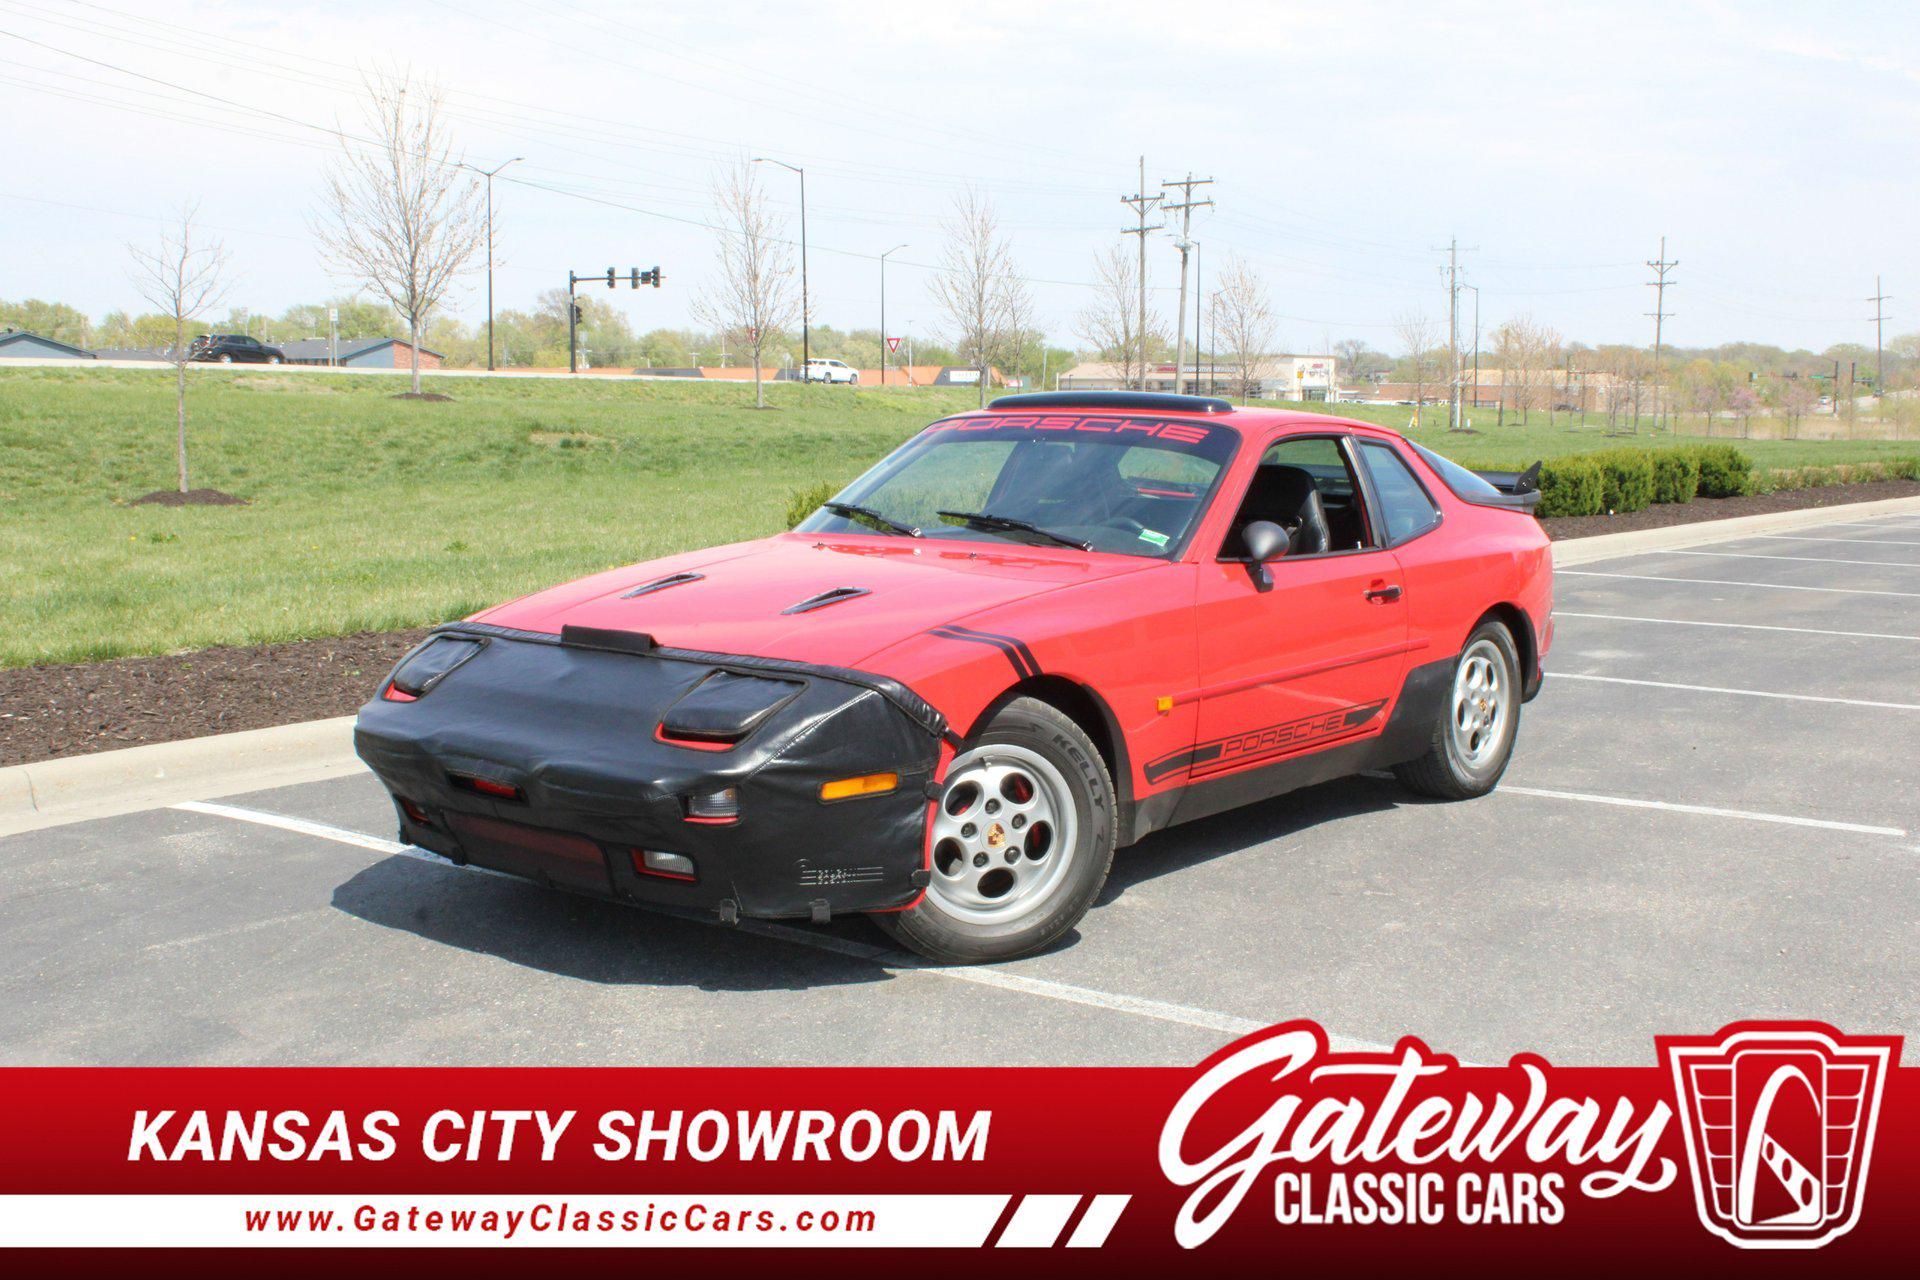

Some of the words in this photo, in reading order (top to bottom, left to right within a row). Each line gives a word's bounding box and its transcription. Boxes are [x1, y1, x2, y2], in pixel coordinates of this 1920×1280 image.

[924, 416, 1210, 444] PORSCHE
[1222, 713, 1345, 756] PORSCHE
[1051, 733, 1105, 812] KELLY
